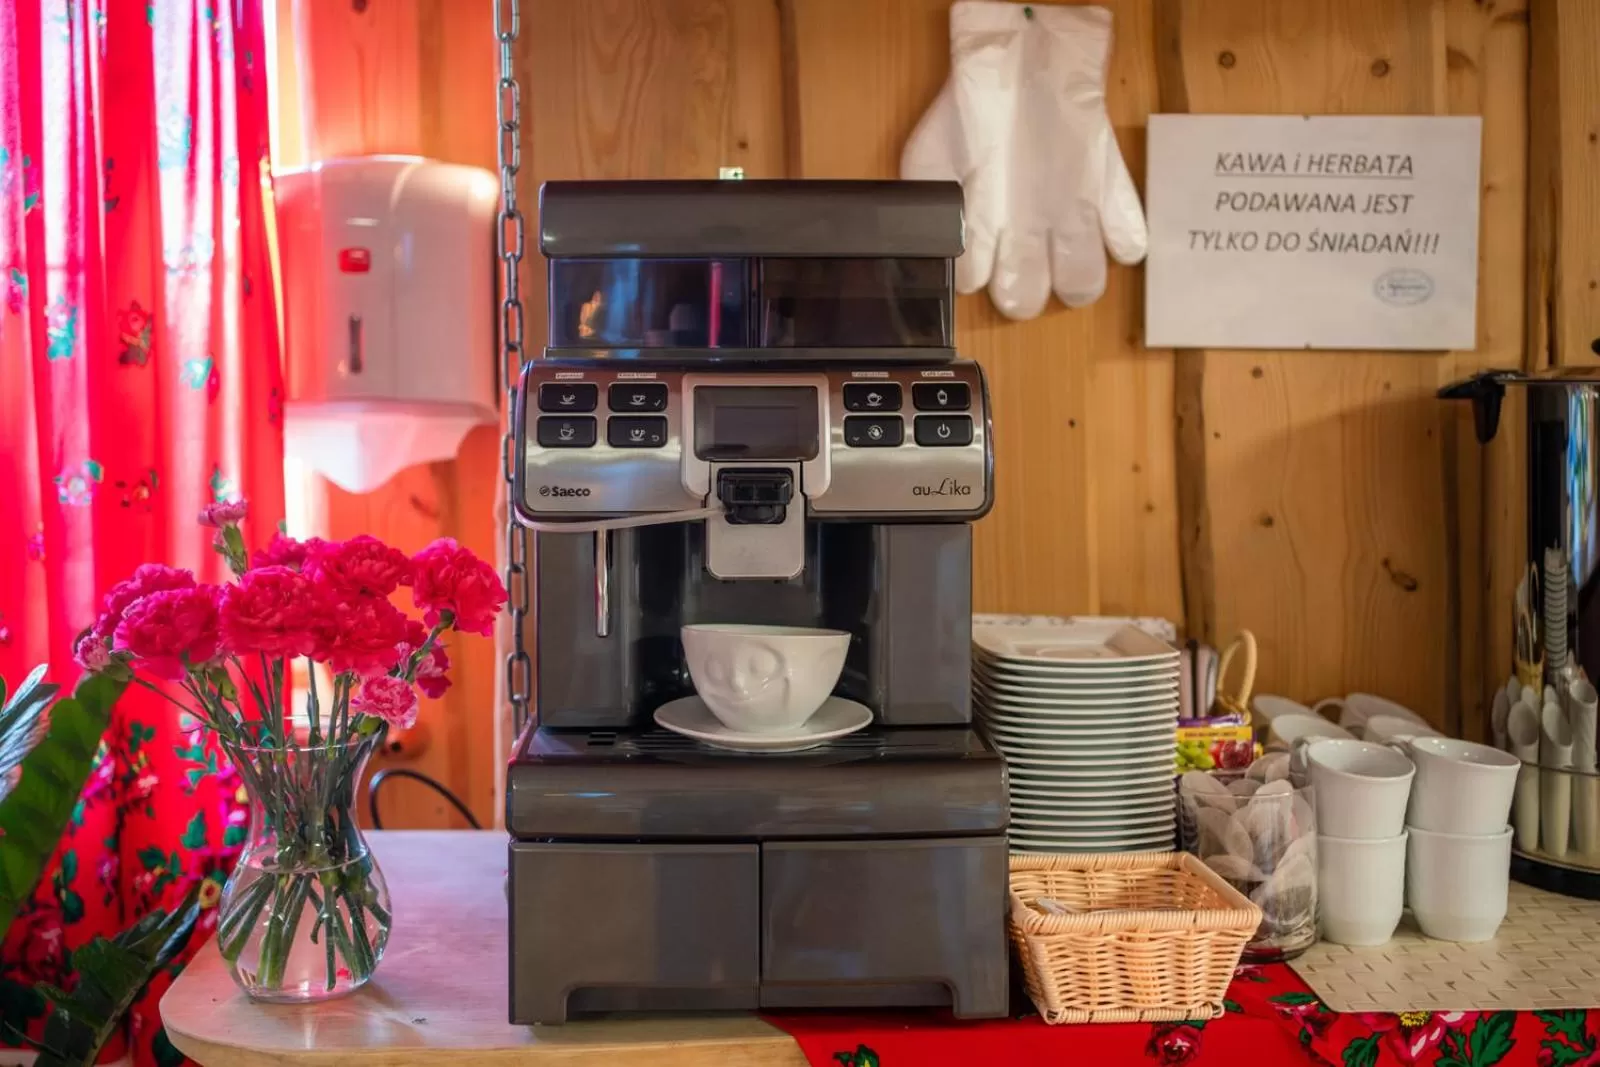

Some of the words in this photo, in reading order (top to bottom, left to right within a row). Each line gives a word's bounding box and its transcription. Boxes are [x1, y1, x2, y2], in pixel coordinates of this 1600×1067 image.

[1215, 152, 1286, 173] KAWA
[1293, 153, 1301, 173] i
[1307, 153, 1414, 175] HERBATA
[1215, 191, 1357, 214] PODAWANA
[1361, 194, 1414, 214] JEST
[1188, 230, 1259, 252] TYLKO
[1265, 232, 1300, 253] DO
[1306, 227, 1440, 255] ŚNIADAŃ!!!
[552, 486, 591, 497] Saeco
